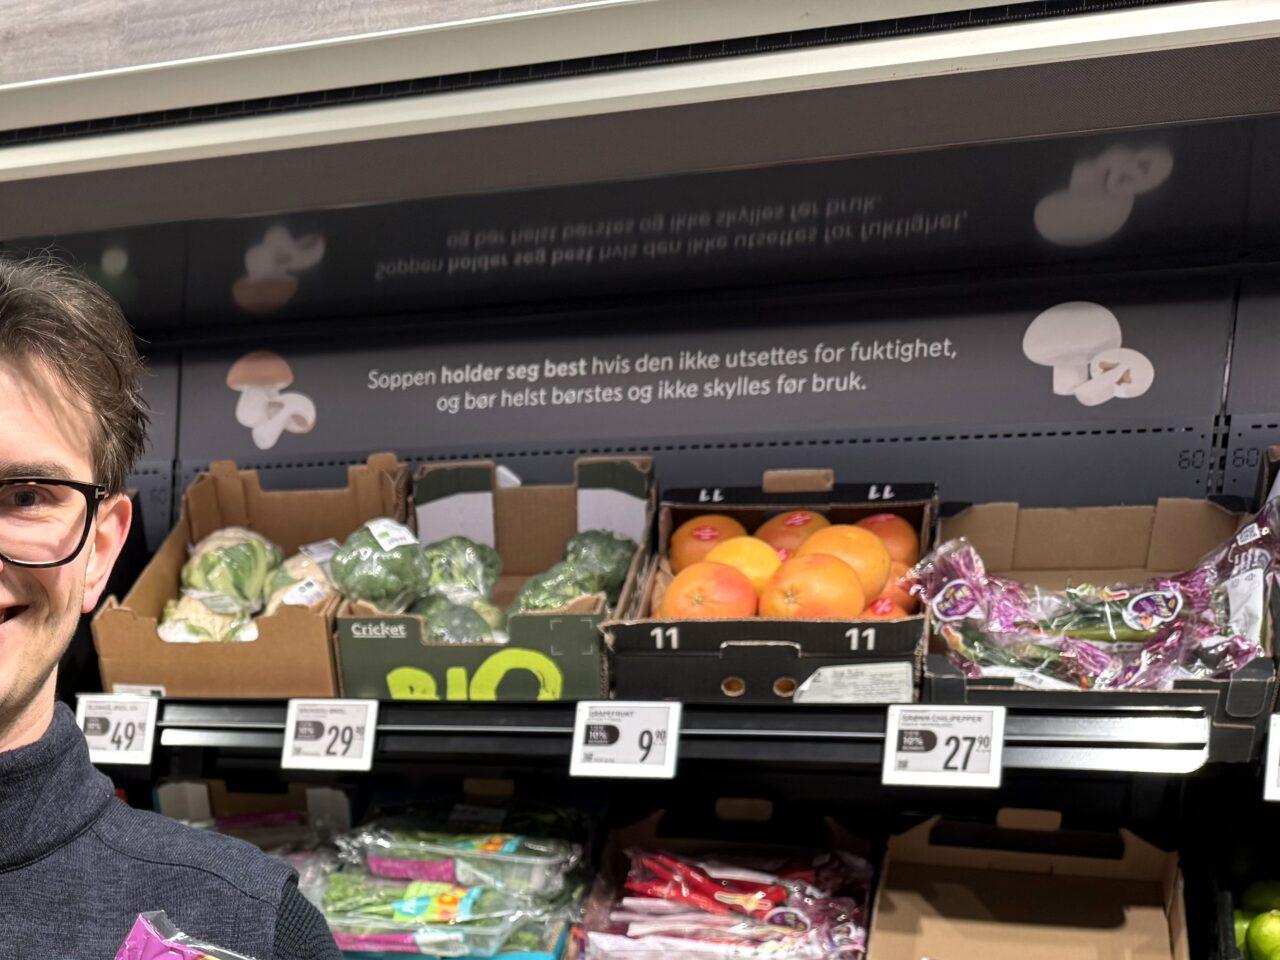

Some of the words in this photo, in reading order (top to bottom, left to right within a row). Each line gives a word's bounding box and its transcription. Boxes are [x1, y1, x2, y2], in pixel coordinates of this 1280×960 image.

[368, 369, 437, 391] Soppen
[441, 364, 503, 385] holder
[506, 364, 540, 382] seg
[544, 357, 588, 378] best
[592, 354, 631, 375] hvis
[635, 353, 674, 373] den
[679, 351, 721, 371] ikke
[725, 346, 809, 369] utsettes
[814, 342, 846, 364] for
[851, 338, 958, 363] fuktighet,
[437, 395, 460, 414] og
[464, 390, 497, 411] bør
[501, 387, 548, 408] helst
[552, 383, 624, 405] børstes
[627, 384, 653, 404] og
[658, 379, 698, 400] ikke
[703, 376, 771, 400] skylles
[777, 373, 807, 395] før
[812, 371, 867, 393] bruk.
[1179, 449, 1205, 470] 60
[1232, 448, 1260, 468] 60
[351, 622, 406, 637] Cricket
[650, 627, 680, 650] 11
[845, 627, 876, 651] 11
[111, 722, 136, 751] 49
[325, 725, 354, 756] 29
[638, 729, 654, 763] 9
[942, 735, 977, 772] 27
